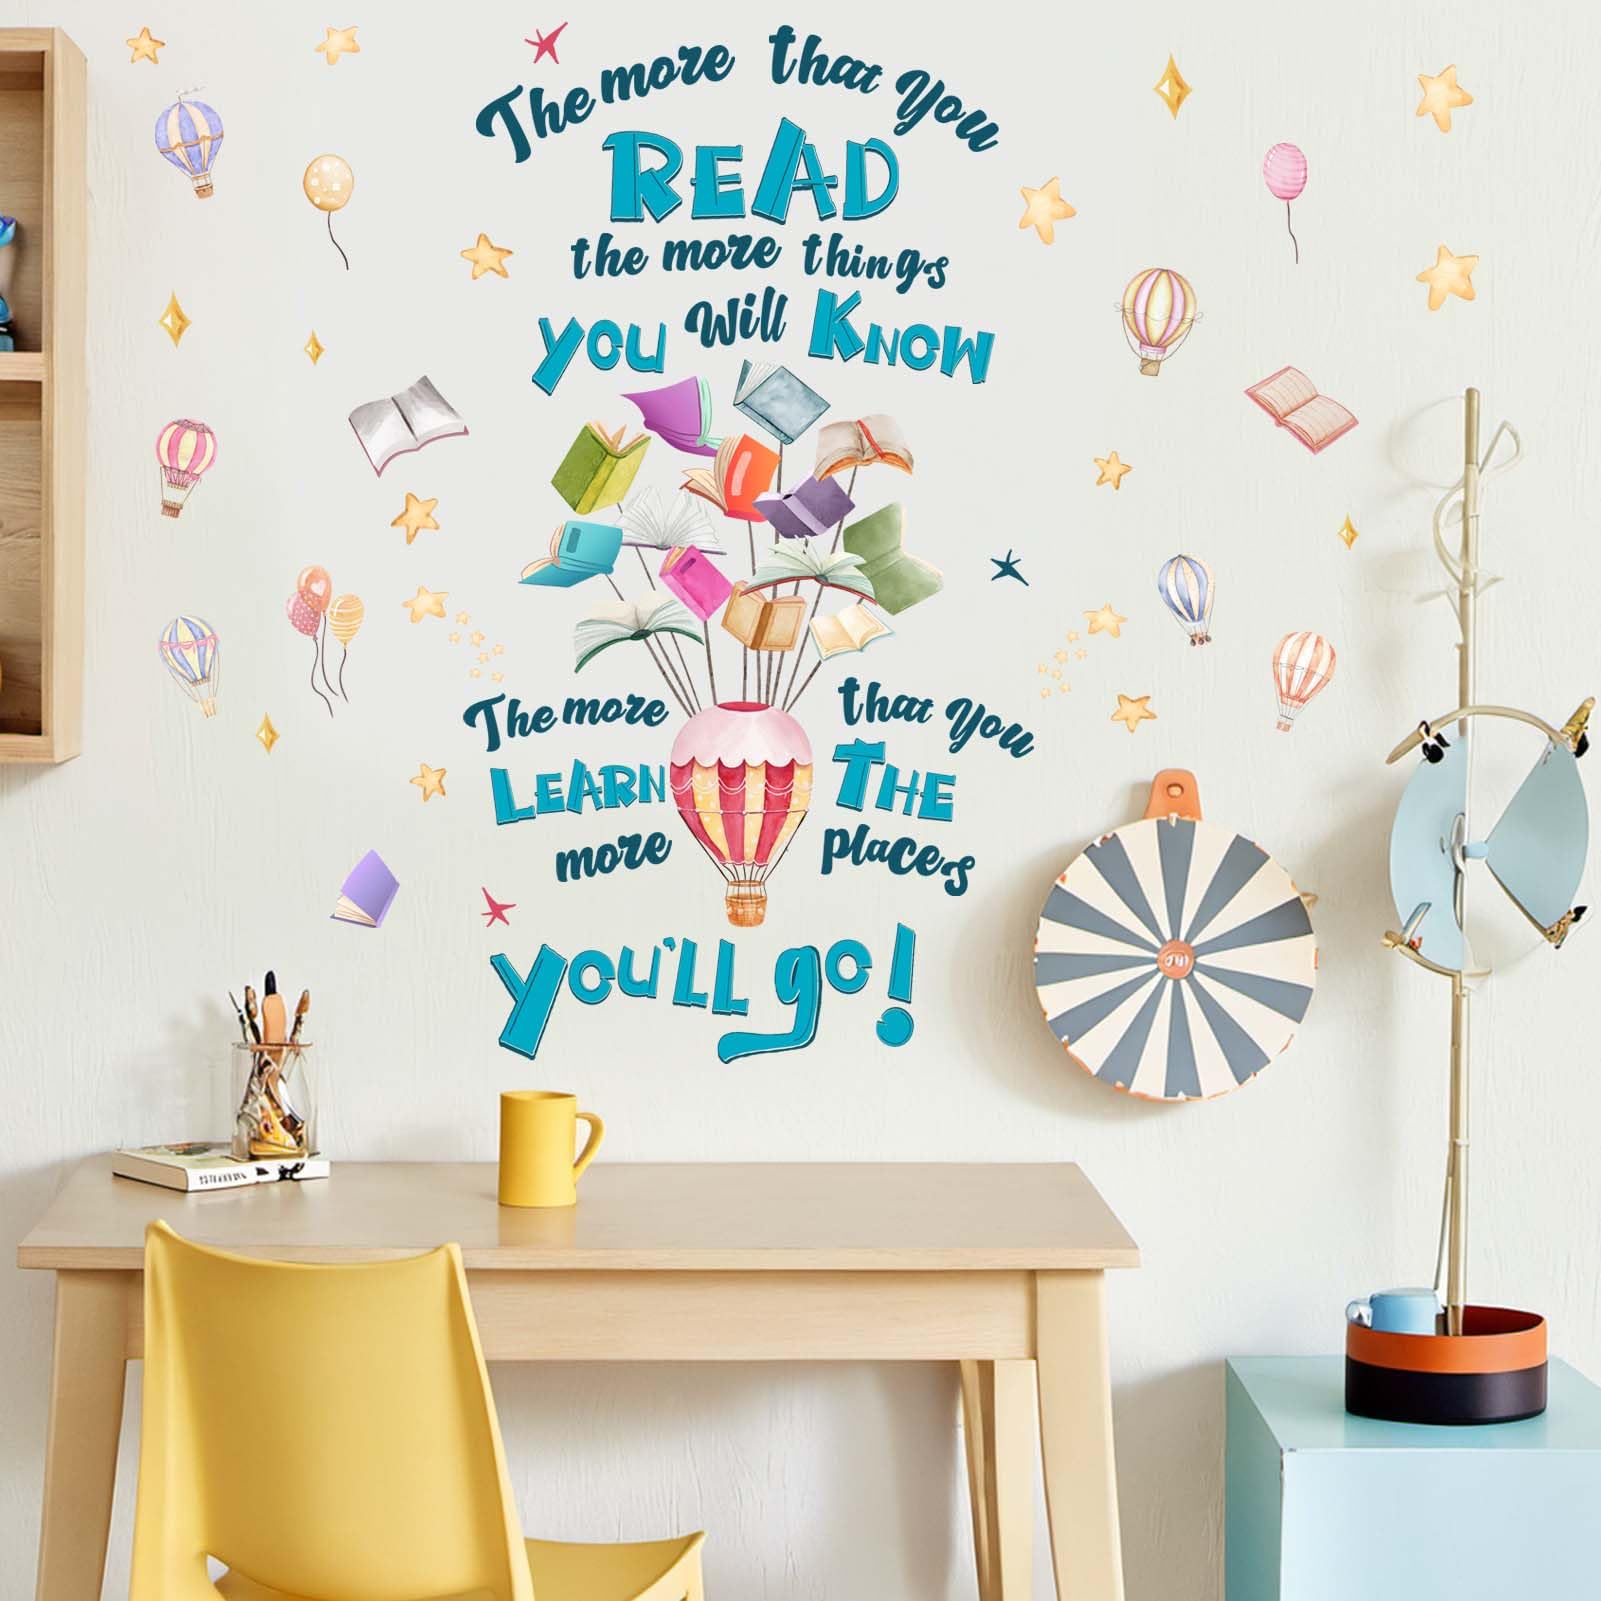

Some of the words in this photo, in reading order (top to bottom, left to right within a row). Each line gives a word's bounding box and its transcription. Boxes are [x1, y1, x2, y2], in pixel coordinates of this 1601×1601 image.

[475, 85, 597, 164] The
[601, 44, 735, 104] more
[769, 24, 882, 94] that
[894, 70, 1000, 153] You
[602, 116, 900, 225] READ
[570, 232, 649, 280] the
[663, 234, 782, 272] more
[802, 232, 949, 295] things
[684, 285, 789, 349] Will
[463, 693, 557, 753] The
[563, 694, 669, 727] more
[838, 676, 934, 725] that
[945, 698, 1035, 759] You
[555, 831, 673, 883] more
[821, 823, 976, 897] places
